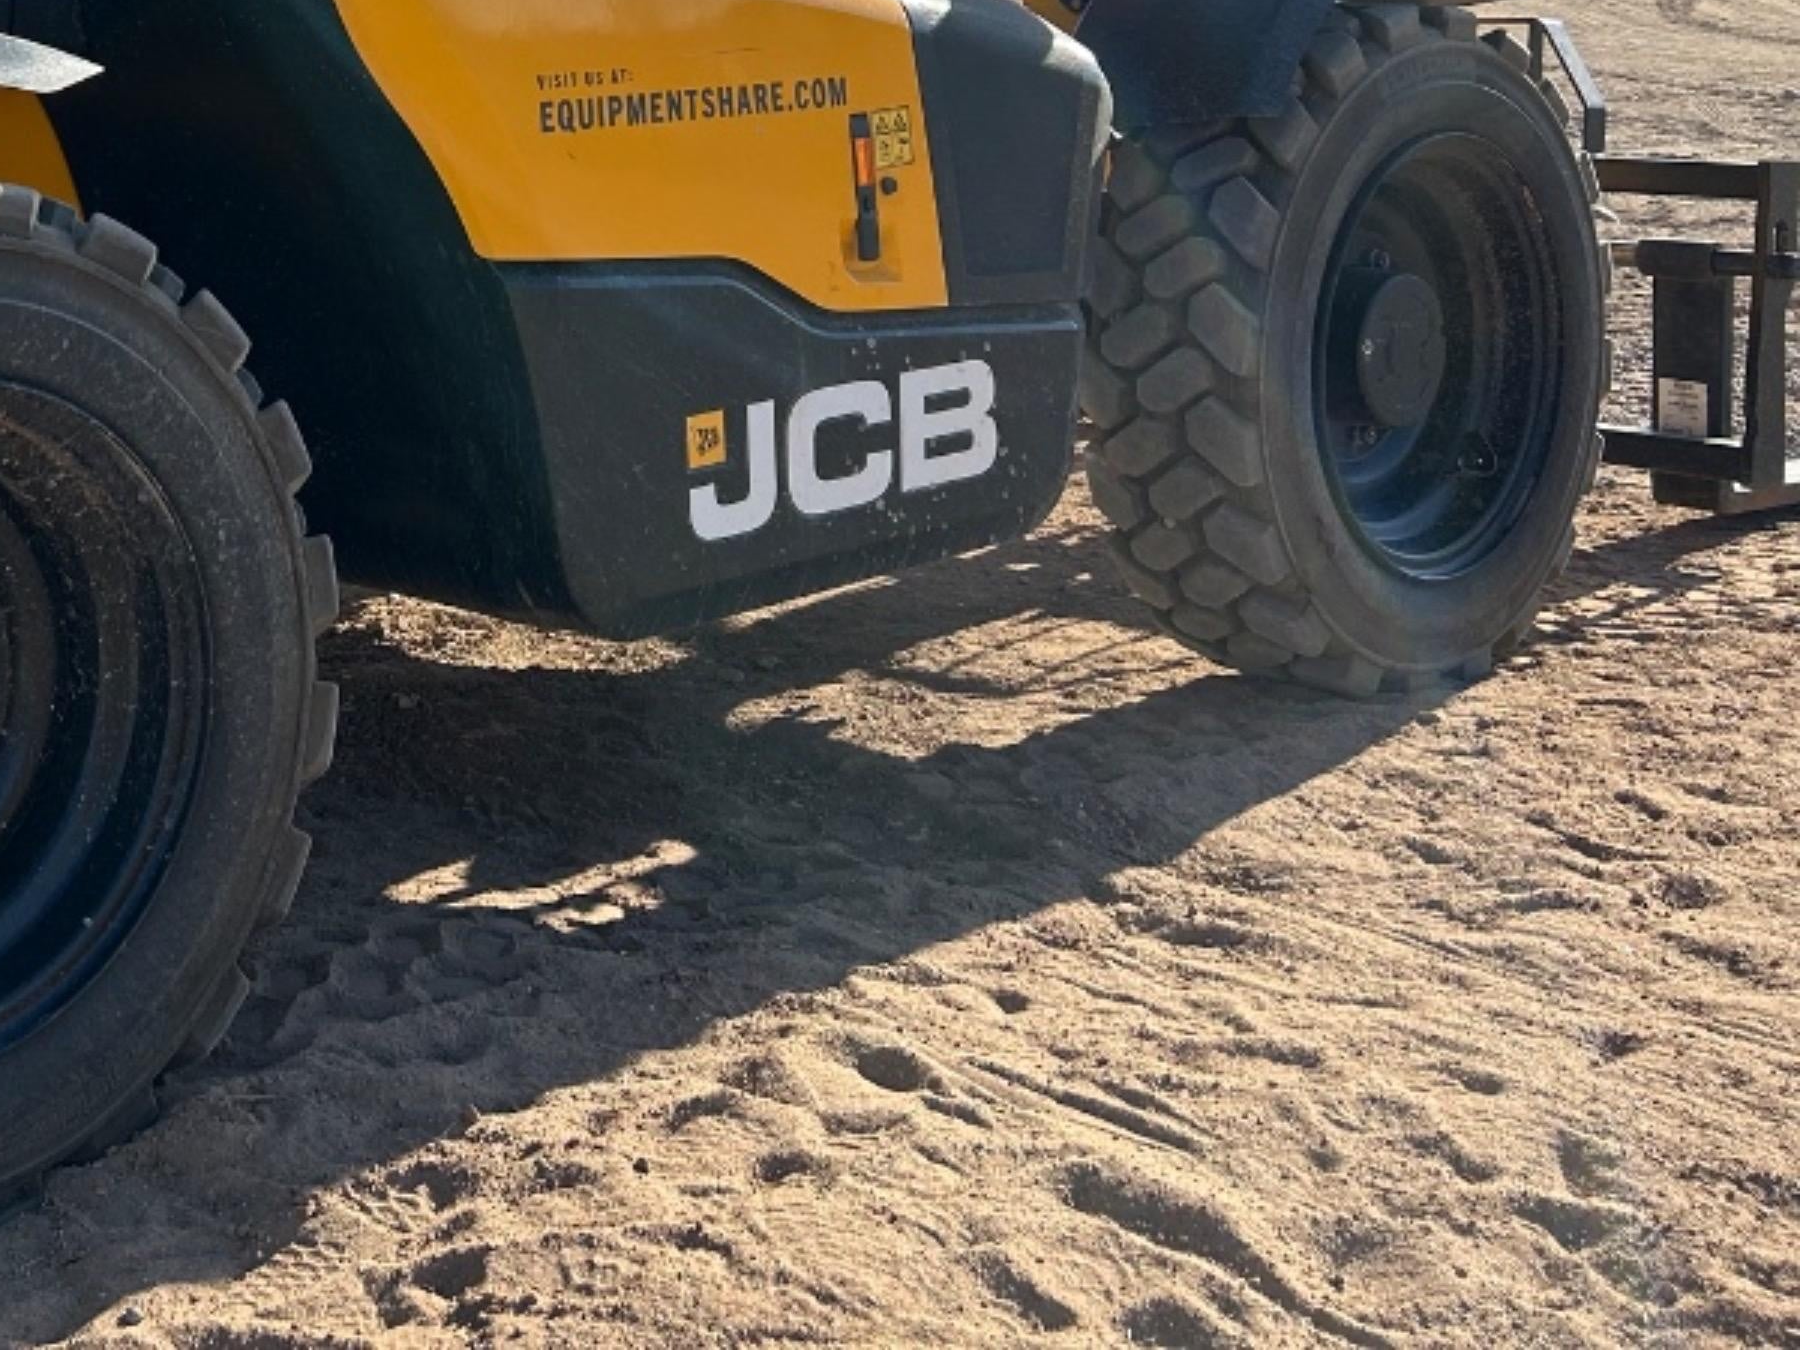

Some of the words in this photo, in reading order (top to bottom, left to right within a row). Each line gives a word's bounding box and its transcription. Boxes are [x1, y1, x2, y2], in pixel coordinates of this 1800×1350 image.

[536, 72, 577, 91] VISIT
[584, 71, 604, 87] US
[538, 75, 849, 134] EQUIPMENTSHARE.COM
[688, 357, 999, 542] JCB
